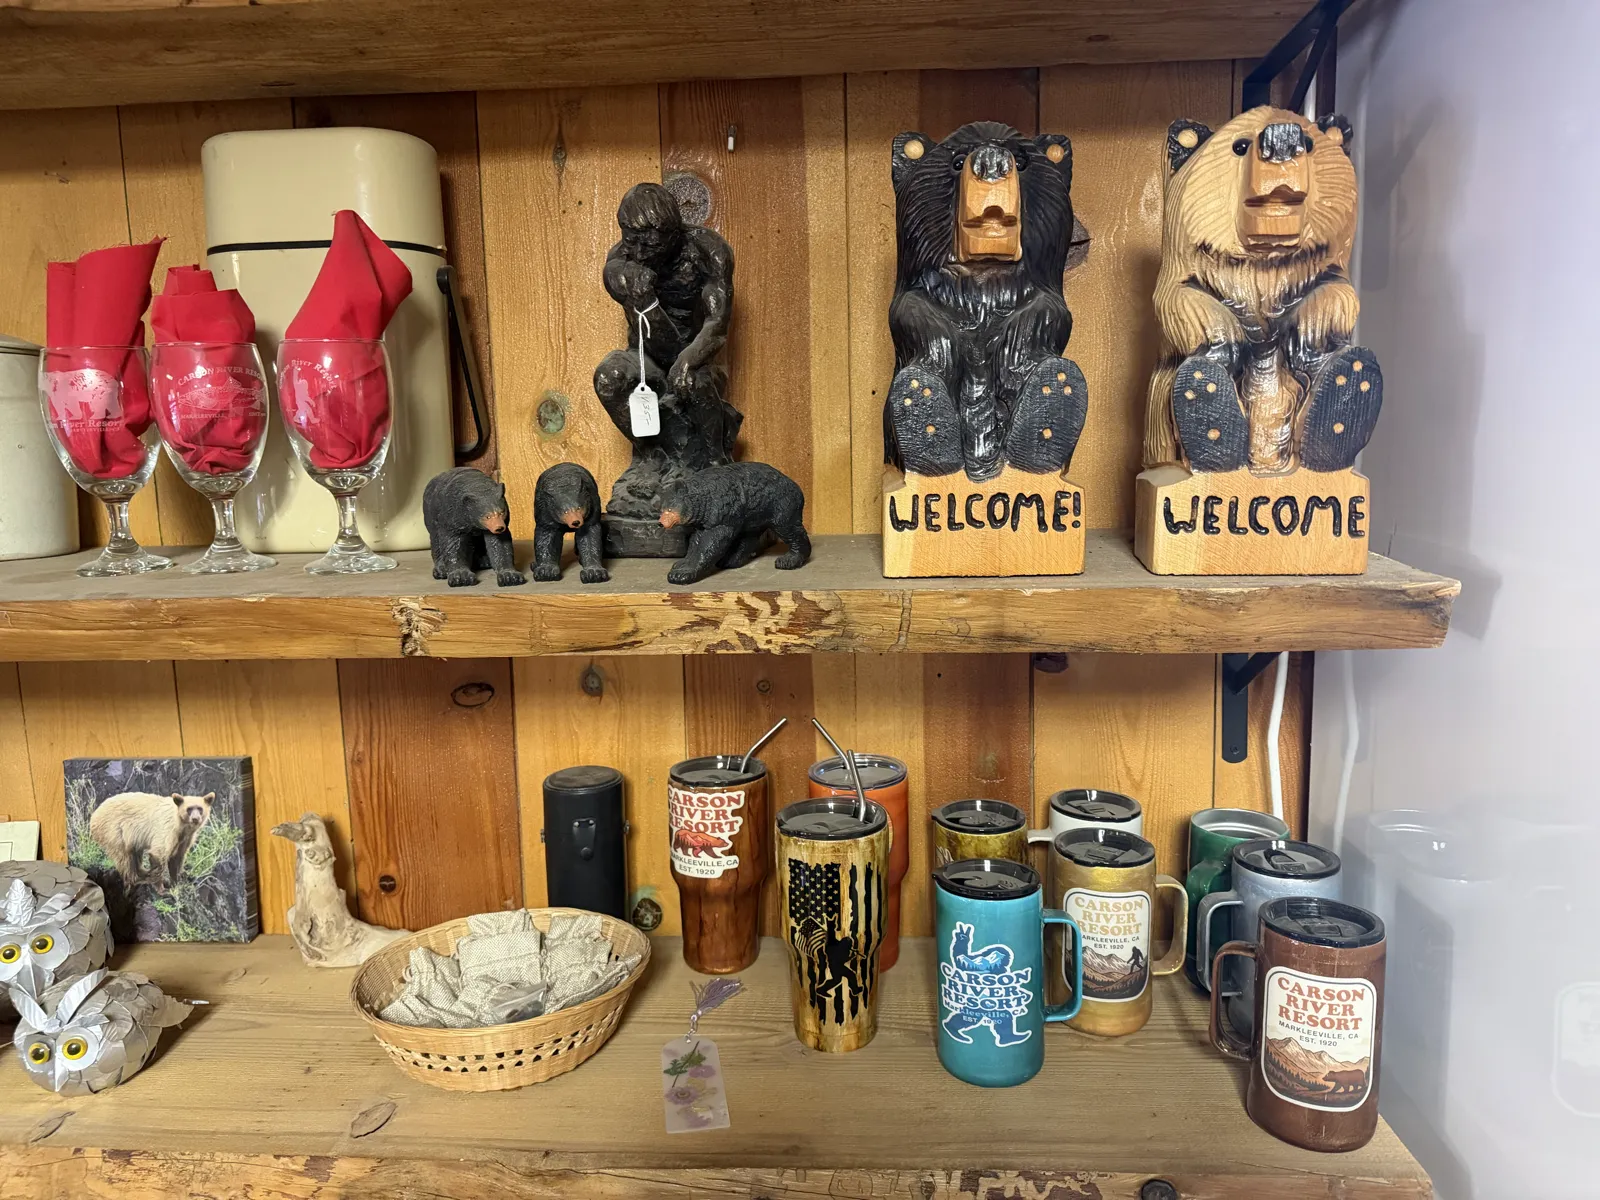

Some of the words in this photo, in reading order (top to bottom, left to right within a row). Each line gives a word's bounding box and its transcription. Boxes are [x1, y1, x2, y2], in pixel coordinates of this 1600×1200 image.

[178, 367, 214, 386] CARON
[889, 490, 1082, 533] WELCOME!
[1163, 495, 1366, 538] WELCOME
[671, 802, 730, 821] RIVER
[679, 864, 693, 873] EST.
[1074, 896, 1144, 912] CARSON
[1082, 910, 1137, 924] RIVER
[1077, 919, 1142, 936] RESORT
[1082, 934, 1130, 943] ARKLEEVILLE,
[942, 965, 1030, 986] CARSON
[943, 986, 1026, 1009] RESORT
[948, 980, 1021, 998] RIVER
[1277, 976, 1366, 1002] CARSON
[1012, 1007, 1026, 1016] CA
[1285, 993, 1355, 1017] RIVER
[1278, 1004, 1363, 1031] RESORT
[1278, 1020, 1346, 1041] MARKLEEVILLE,
[1299, 1035, 1317, 1044] EST.
[1319, 1039, 1338, 1047] 1920
